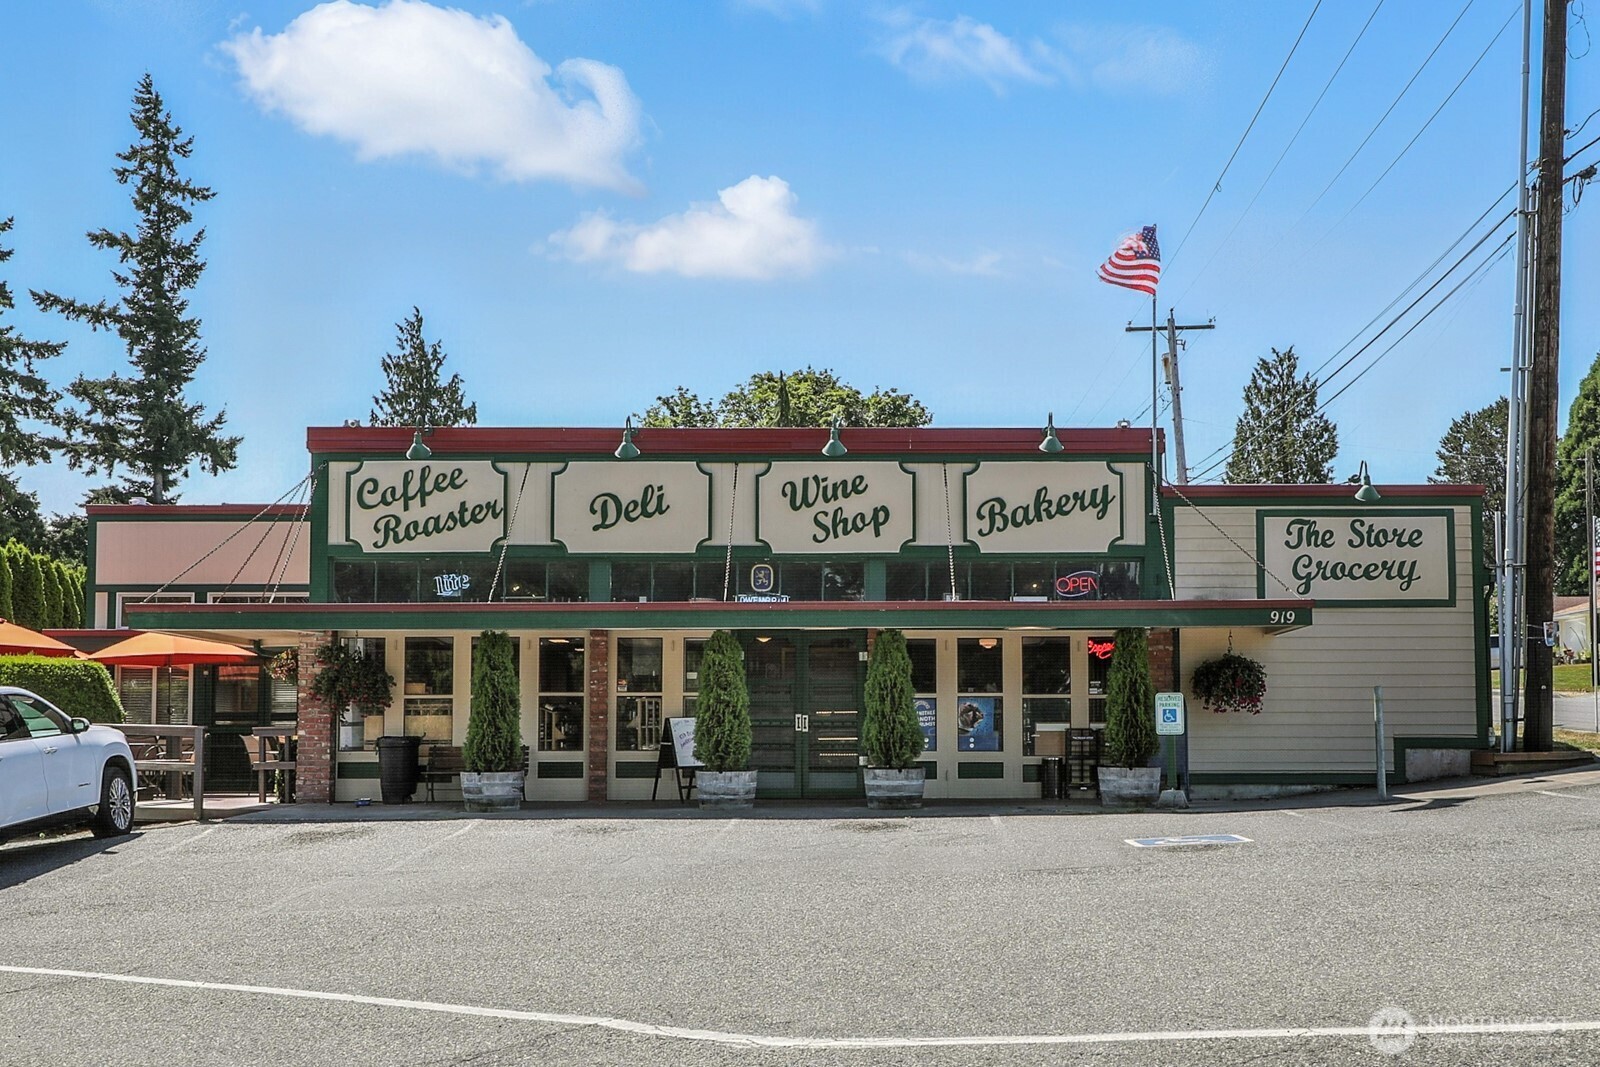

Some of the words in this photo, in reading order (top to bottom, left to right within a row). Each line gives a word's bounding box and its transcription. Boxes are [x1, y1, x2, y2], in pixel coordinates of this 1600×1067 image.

[357, 465, 468, 512] Coffee
[590, 484, 670, 531] Deli
[782, 474, 868, 511] Wine
[372, 499, 503, 549] Roaster
[812, 505, 890, 543] Shop
[976, 484, 1116, 537] Bakery
[1284, 518, 1335, 549] The
[1347, 518, 1423, 548] Store
[433, 574, 470, 596] Lite
[1056, 576, 1098, 592] OPEN
[1291, 554, 1421, 595] Grocery
[1270, 610, 1296, 624] 919
